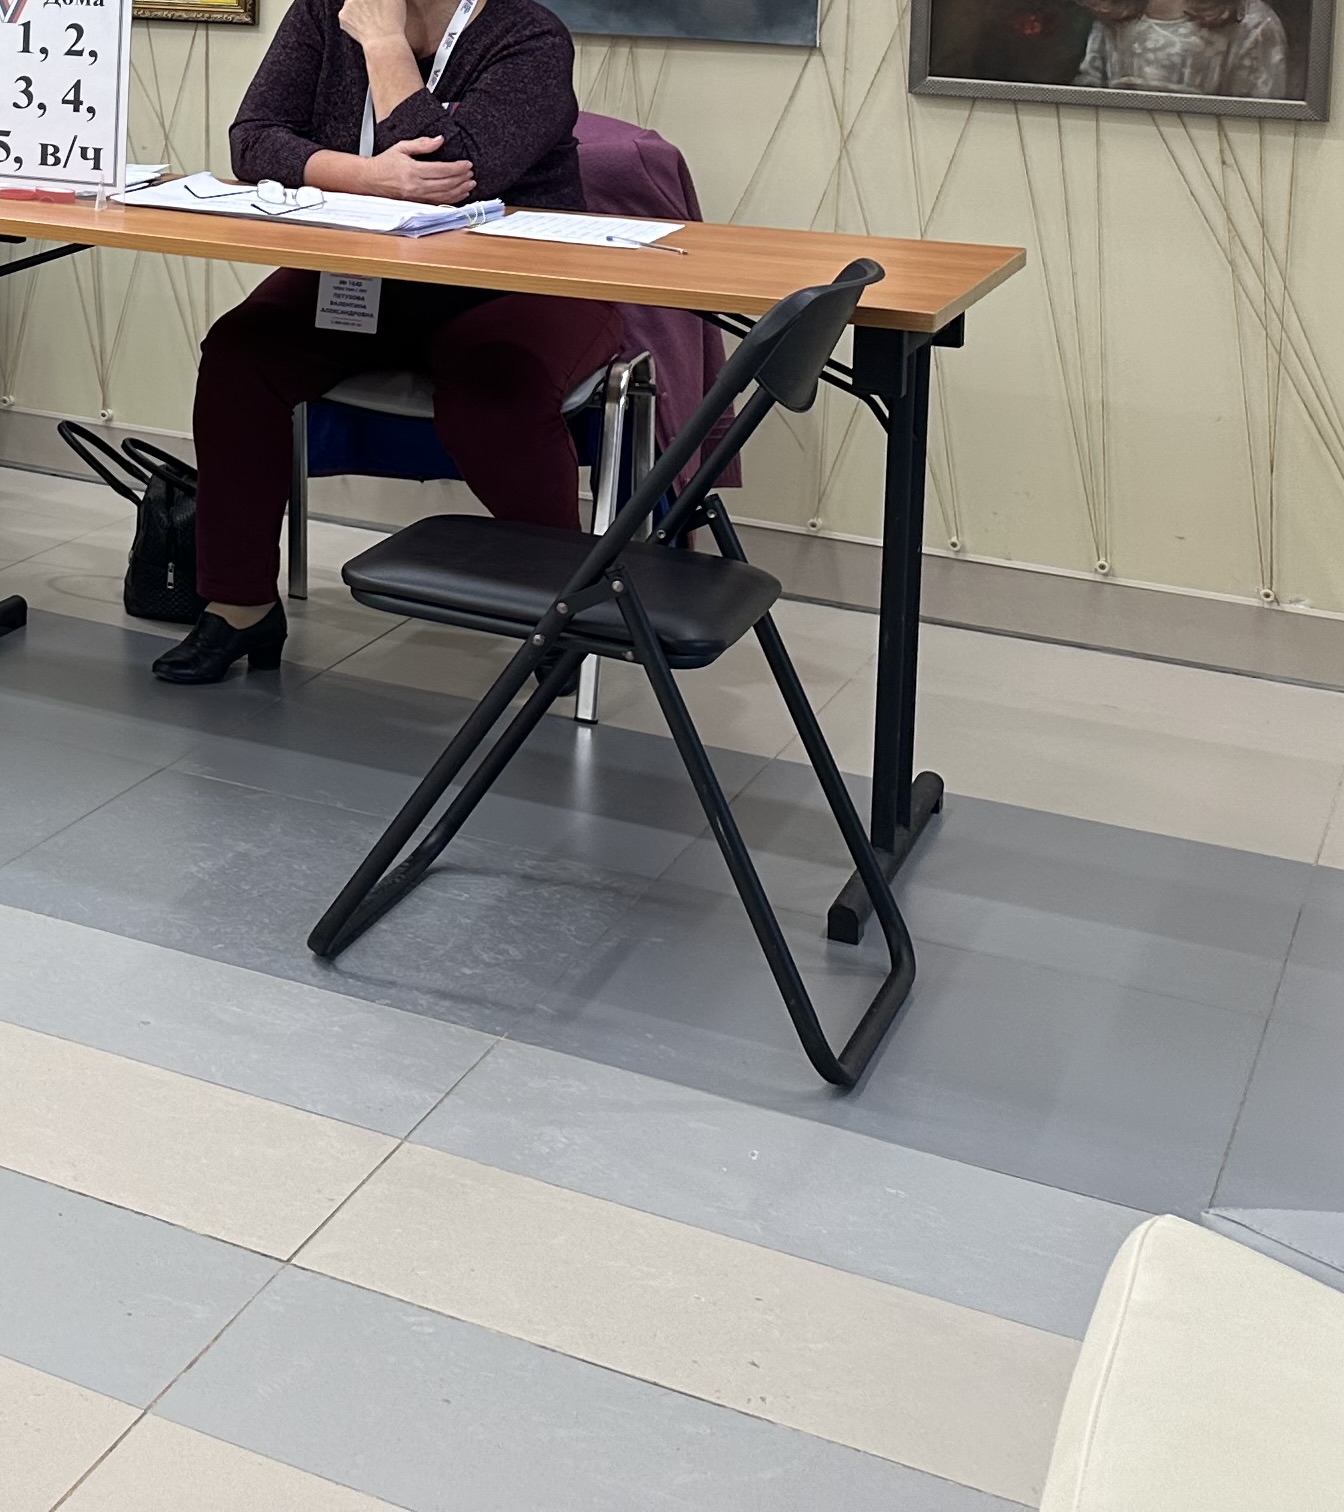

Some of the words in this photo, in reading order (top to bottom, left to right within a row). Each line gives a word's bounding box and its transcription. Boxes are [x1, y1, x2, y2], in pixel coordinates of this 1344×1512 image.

[17, 20, 49, 62] 1,
[63, 22, 99, 66] 2,
[12, 75, 47, 118] 3,
[61, 79, 97, 122] 4,
[38, 135, 104, 171] в/ч
